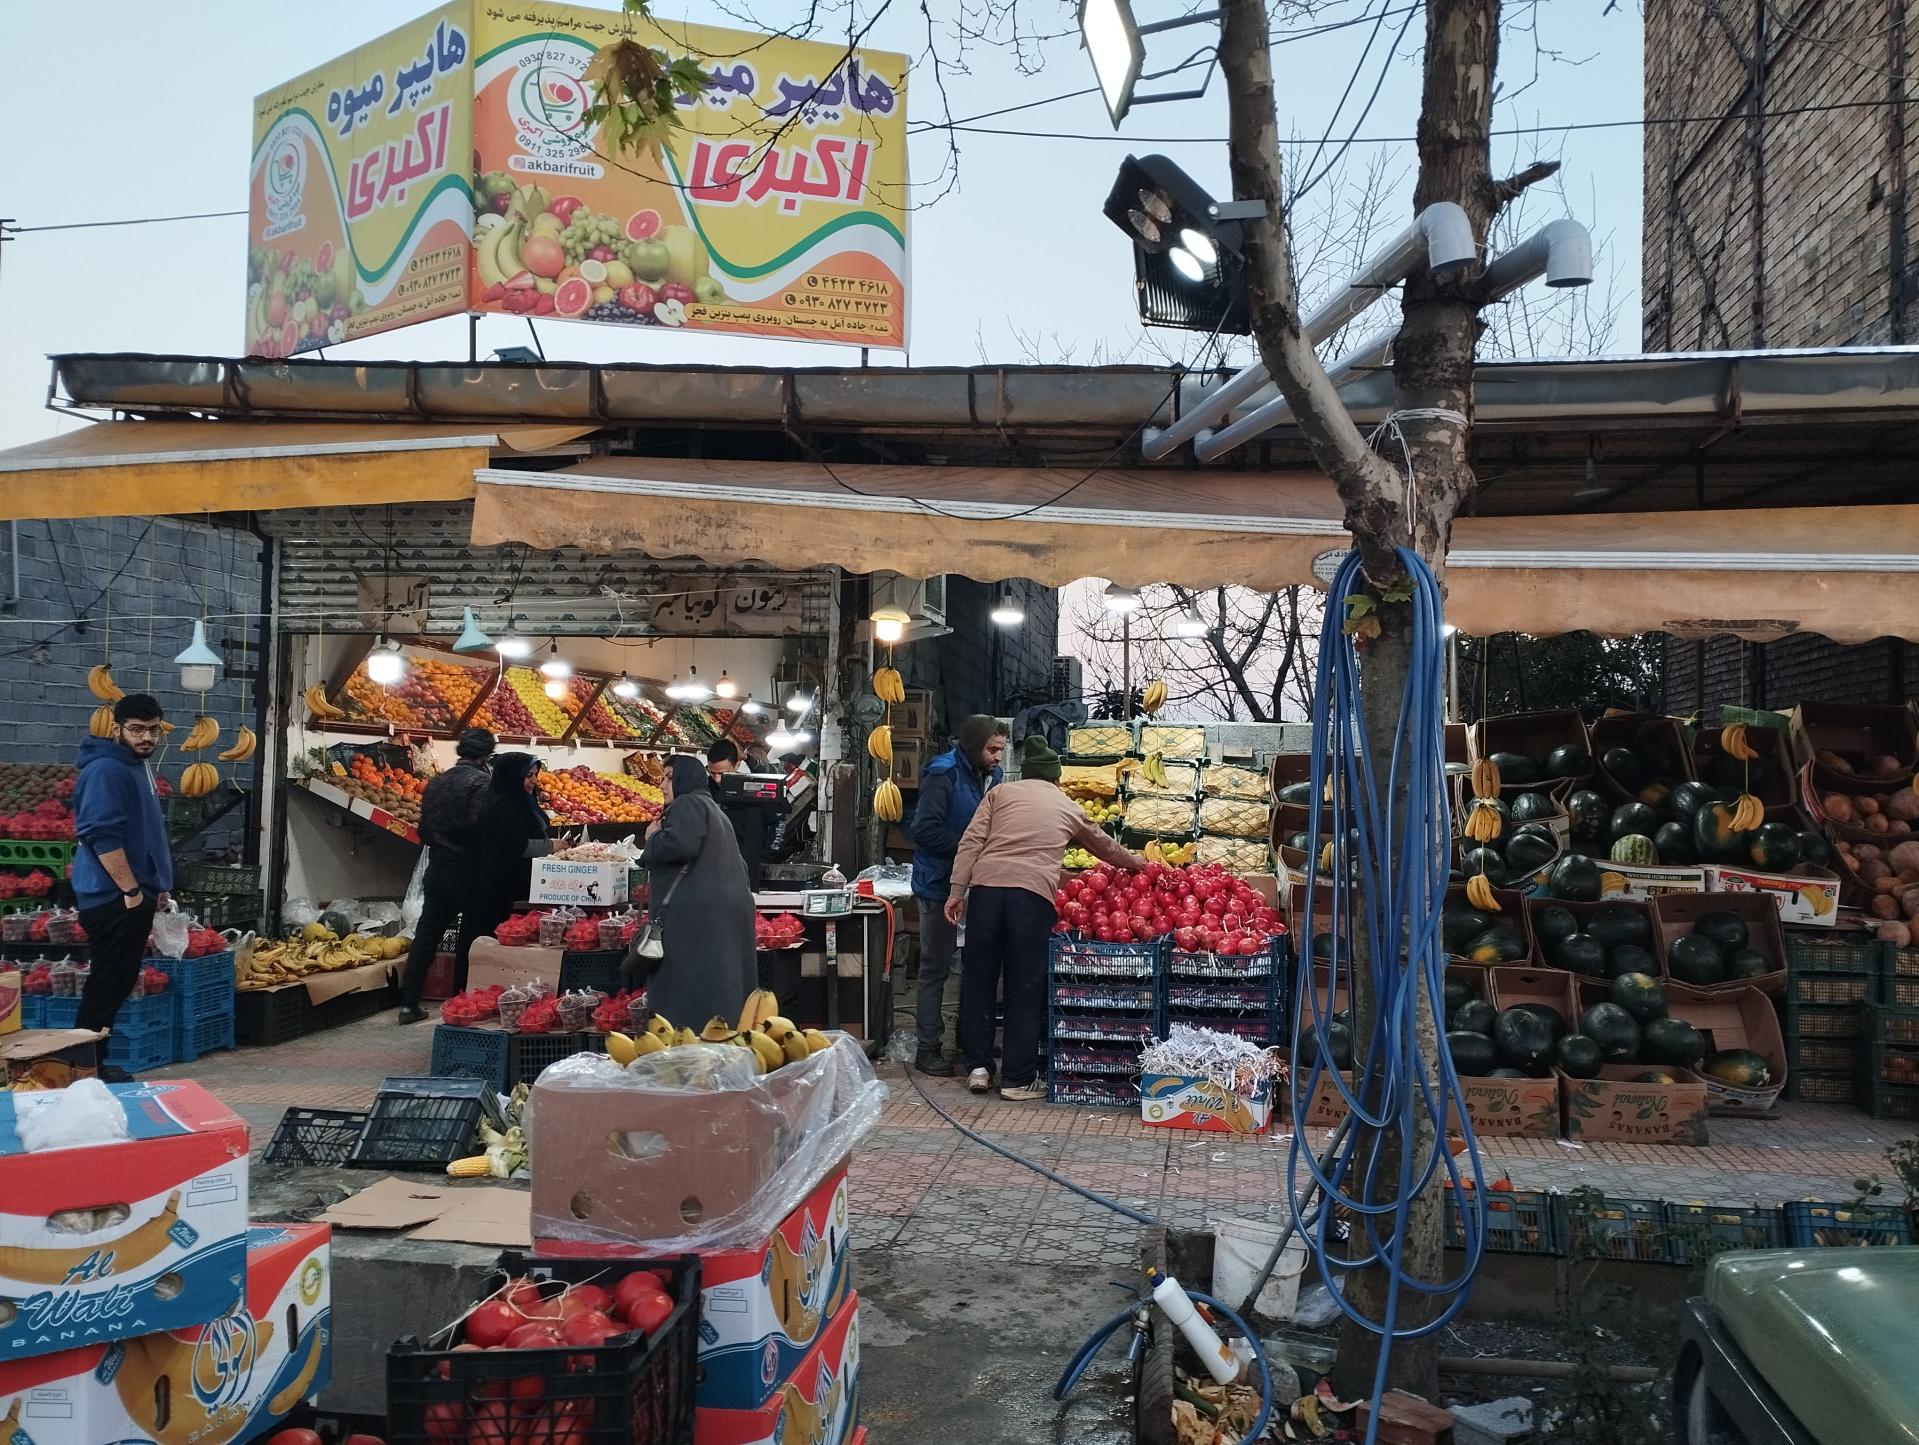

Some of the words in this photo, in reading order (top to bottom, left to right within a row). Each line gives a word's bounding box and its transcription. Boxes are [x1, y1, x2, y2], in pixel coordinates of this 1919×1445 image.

[486, 7, 504, 21] شود
[506, 13, 522, 23] می
[524, 11, 555, 29] پذیرفته
[556, 16, 582, 32] مراسم
[584, 20, 606, 34] جهت
[608, 22, 638, 37] سفارش
[387, 20, 467, 107] هایپر
[519, 52, 545, 68] 0930
[546, 51, 566, 61] 827
[568, 55, 588, 72] 372
[764, 58, 895, 126] هایپر
[327, 73, 384, 136] میوه
[518, 116, 545, 138] اکبری
[518, 134, 542, 154] 0911
[545, 147, 565, 159] 325
[347, 104, 450, 219] اکبری
[527, 160, 596, 177] akbarifruit
[689, 138, 869, 211] اکبری
[442, 246, 461, 261] ۴۶۱۸
[406, 279, 421, 297] ۰۹۳۰
[423, 274, 438, 290] ۸۲۷
[440, 267, 461, 283] ۳۷۲۳
[822, 275, 855, 289] ۴۴۲۳
[859, 280, 888, 295] ۴۶۱۸
[690, 305, 707, 318] فجر
[799, 295, 825, 309] ۰۹۳۰
[828, 297, 851, 311] ۸۲۷
[854, 301, 888, 315] ۳۷۲۳
[709, 309, 731, 321] بنزین
[733, 312, 750, 323] پمپ
[753, 313, 782, 325] روبروی
[830, 317, 845, 330] آمل
[819, 319, 828, 329] به
[846, 320, 866, 333] جاده
[685, 583, 720, 624] لوبیا
[542, 863, 567, 873] FRESH
[568, 865, 598, 875] GINGER
[539, 893, 570, 902] PRODUCE
[571, 894, 580, 902] OF
[1184, 1094, 1225, 1111] Wali
[1464, 1086, 1519, 1105] Natural
[1612, 1093, 1668, 1113] Natural
[1193, 1111, 1213, 1126] Al
[1608, 1120, 1670, 1134] BANANAS
[60, 1249, 116, 1287] Al
[23, 1283, 135, 1331] Wali
[11, 1319, 147, 1348] BANANA
[187, 1393, 264, 1444] BANANA
